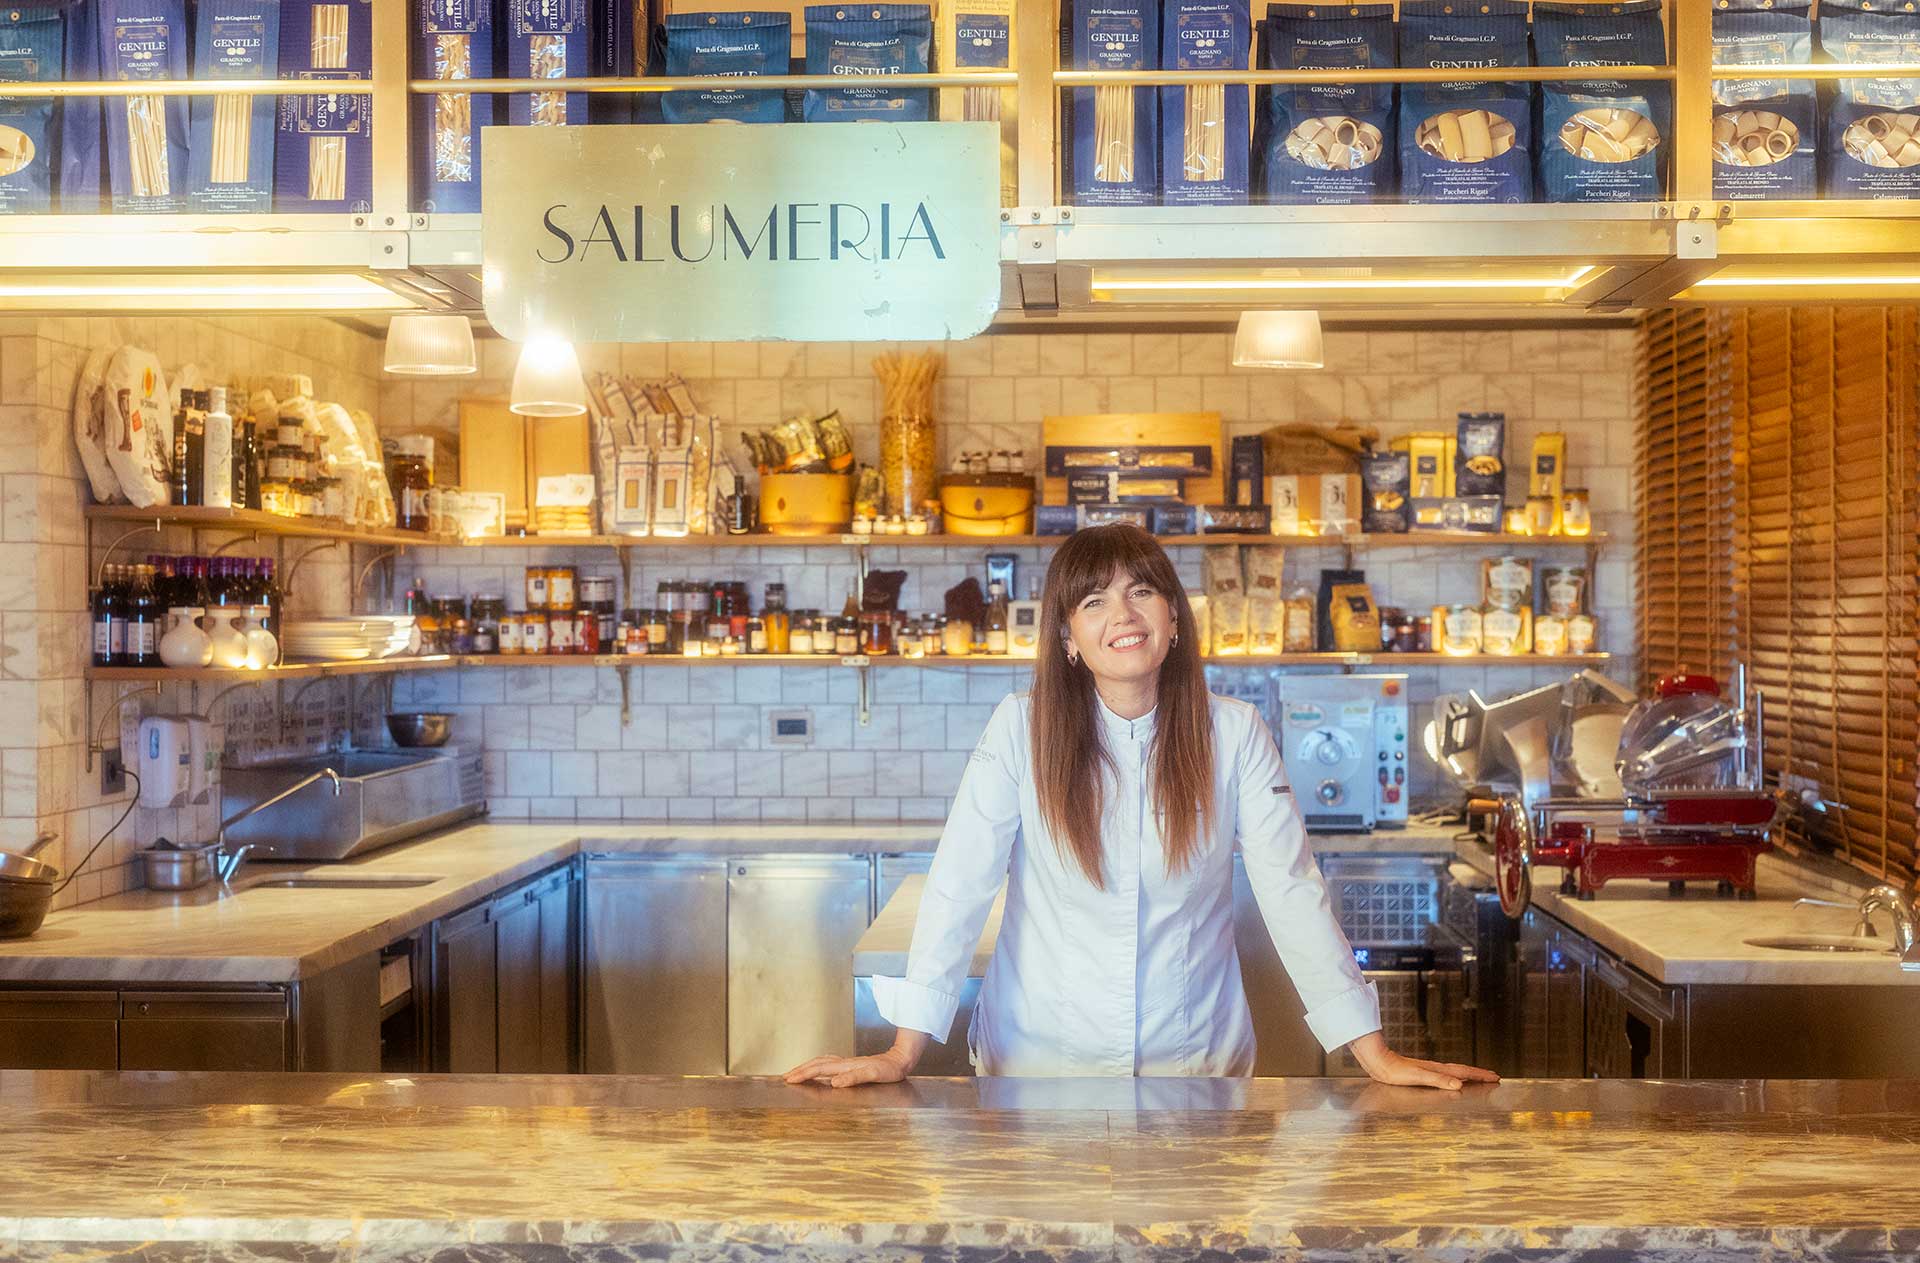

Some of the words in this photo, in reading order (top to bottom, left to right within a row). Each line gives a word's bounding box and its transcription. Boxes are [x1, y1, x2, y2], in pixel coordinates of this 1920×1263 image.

[959, 29, 1007, 38] GENTILE
[1091, 33, 1139, 42] GENTILE
[1181, 30, 1230, 39] GENTILE
[118, 41, 166, 51] GENTILE
[213, 38, 261, 48] GENTILE
[1430, 58, 1498, 69] GENTILE
[833, 65, 900, 75] GENTILE
[1311, 86, 1355, 95] GRAGNANO
[1470, 188, 1488, 197] Rigati
[1612, 190, 1631, 198] Rigati
[536, 201, 946, 264] SALUMERIA
